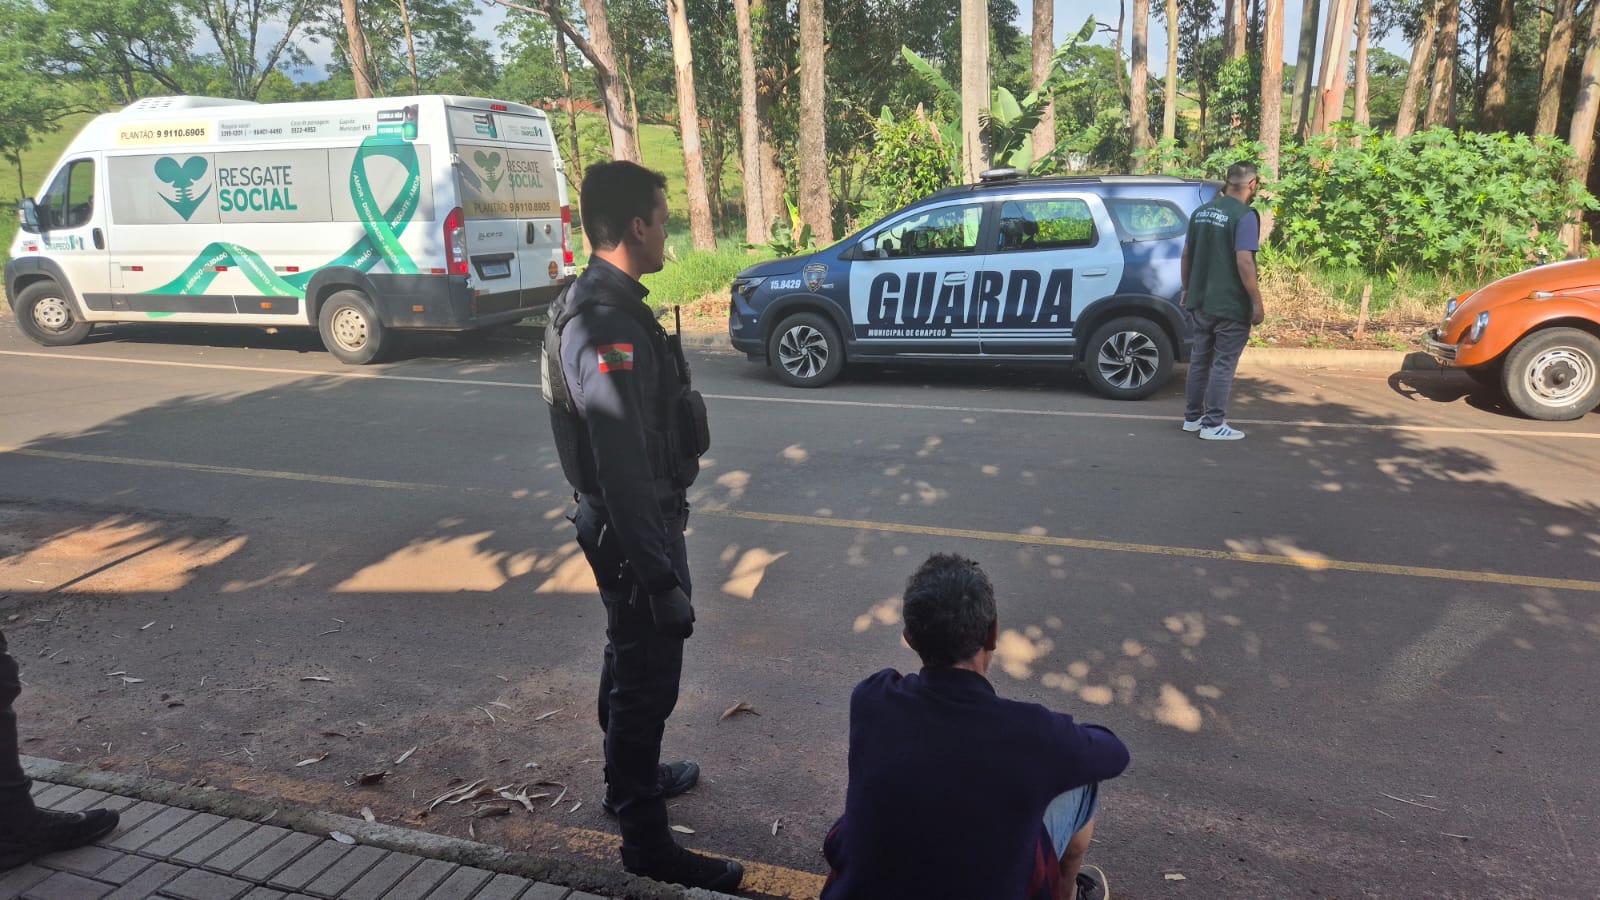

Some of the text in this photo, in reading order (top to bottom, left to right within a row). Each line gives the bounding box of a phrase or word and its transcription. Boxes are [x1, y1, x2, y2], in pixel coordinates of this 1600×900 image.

[121, 128, 205, 140] PLANTÃO: 9 9110.6905
[506, 161, 540, 173] RESGATE
[219, 165, 293, 187] RESGATE
[508, 173, 543, 188] SOCIAL
[353, 174, 364, 198] AMOR
[220, 187, 298, 212] SOCIAL
[770, 279, 801, 289] 15.8429
[867, 268, 1074, 326] GUARDA
[868, 327, 947, 337] MUNICIPAL DE CHAPECÓ
